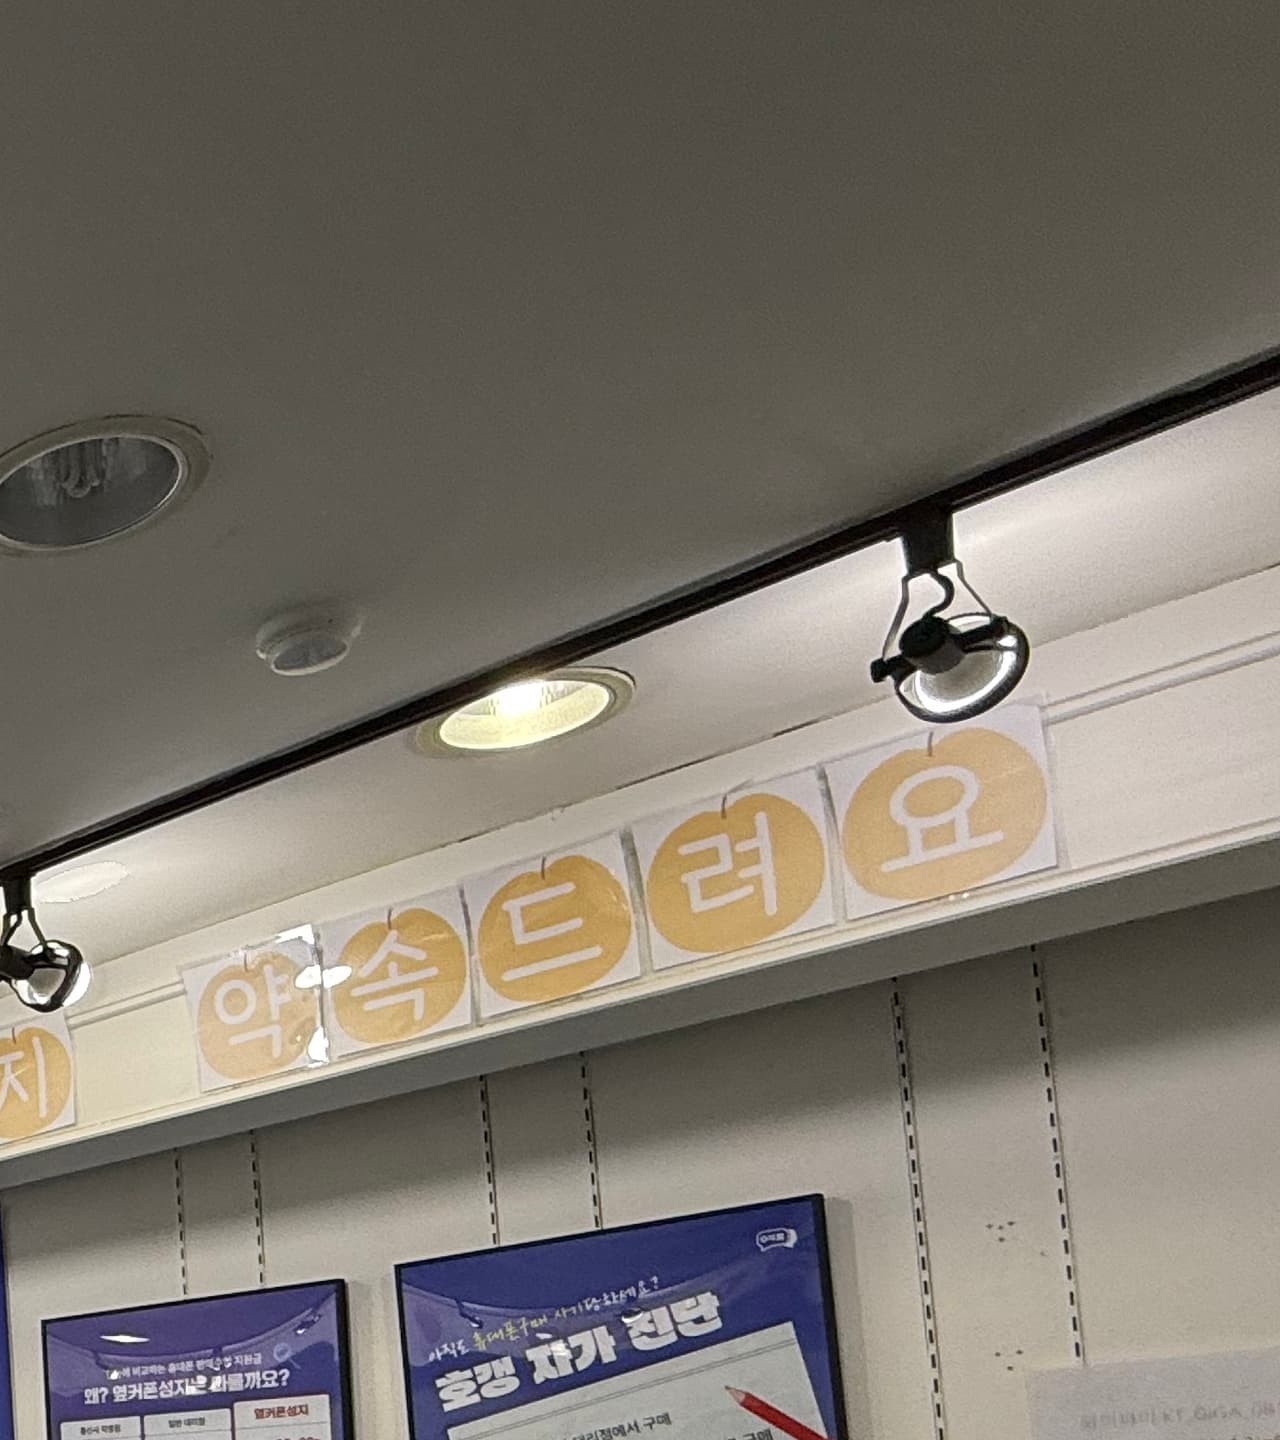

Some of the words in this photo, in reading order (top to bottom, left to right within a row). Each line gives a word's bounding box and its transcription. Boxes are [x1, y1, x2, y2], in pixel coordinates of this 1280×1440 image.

[213, 764, 1003, 1059] 약속드려요
[435, 1356, 521, 1413] 호갱
[525, 1325, 618, 1385] 자가
[625, 1291, 723, 1352] 진단
[84, 1387, 108, 1405] 왜?
[643, 1412, 672, 1431] 구매
